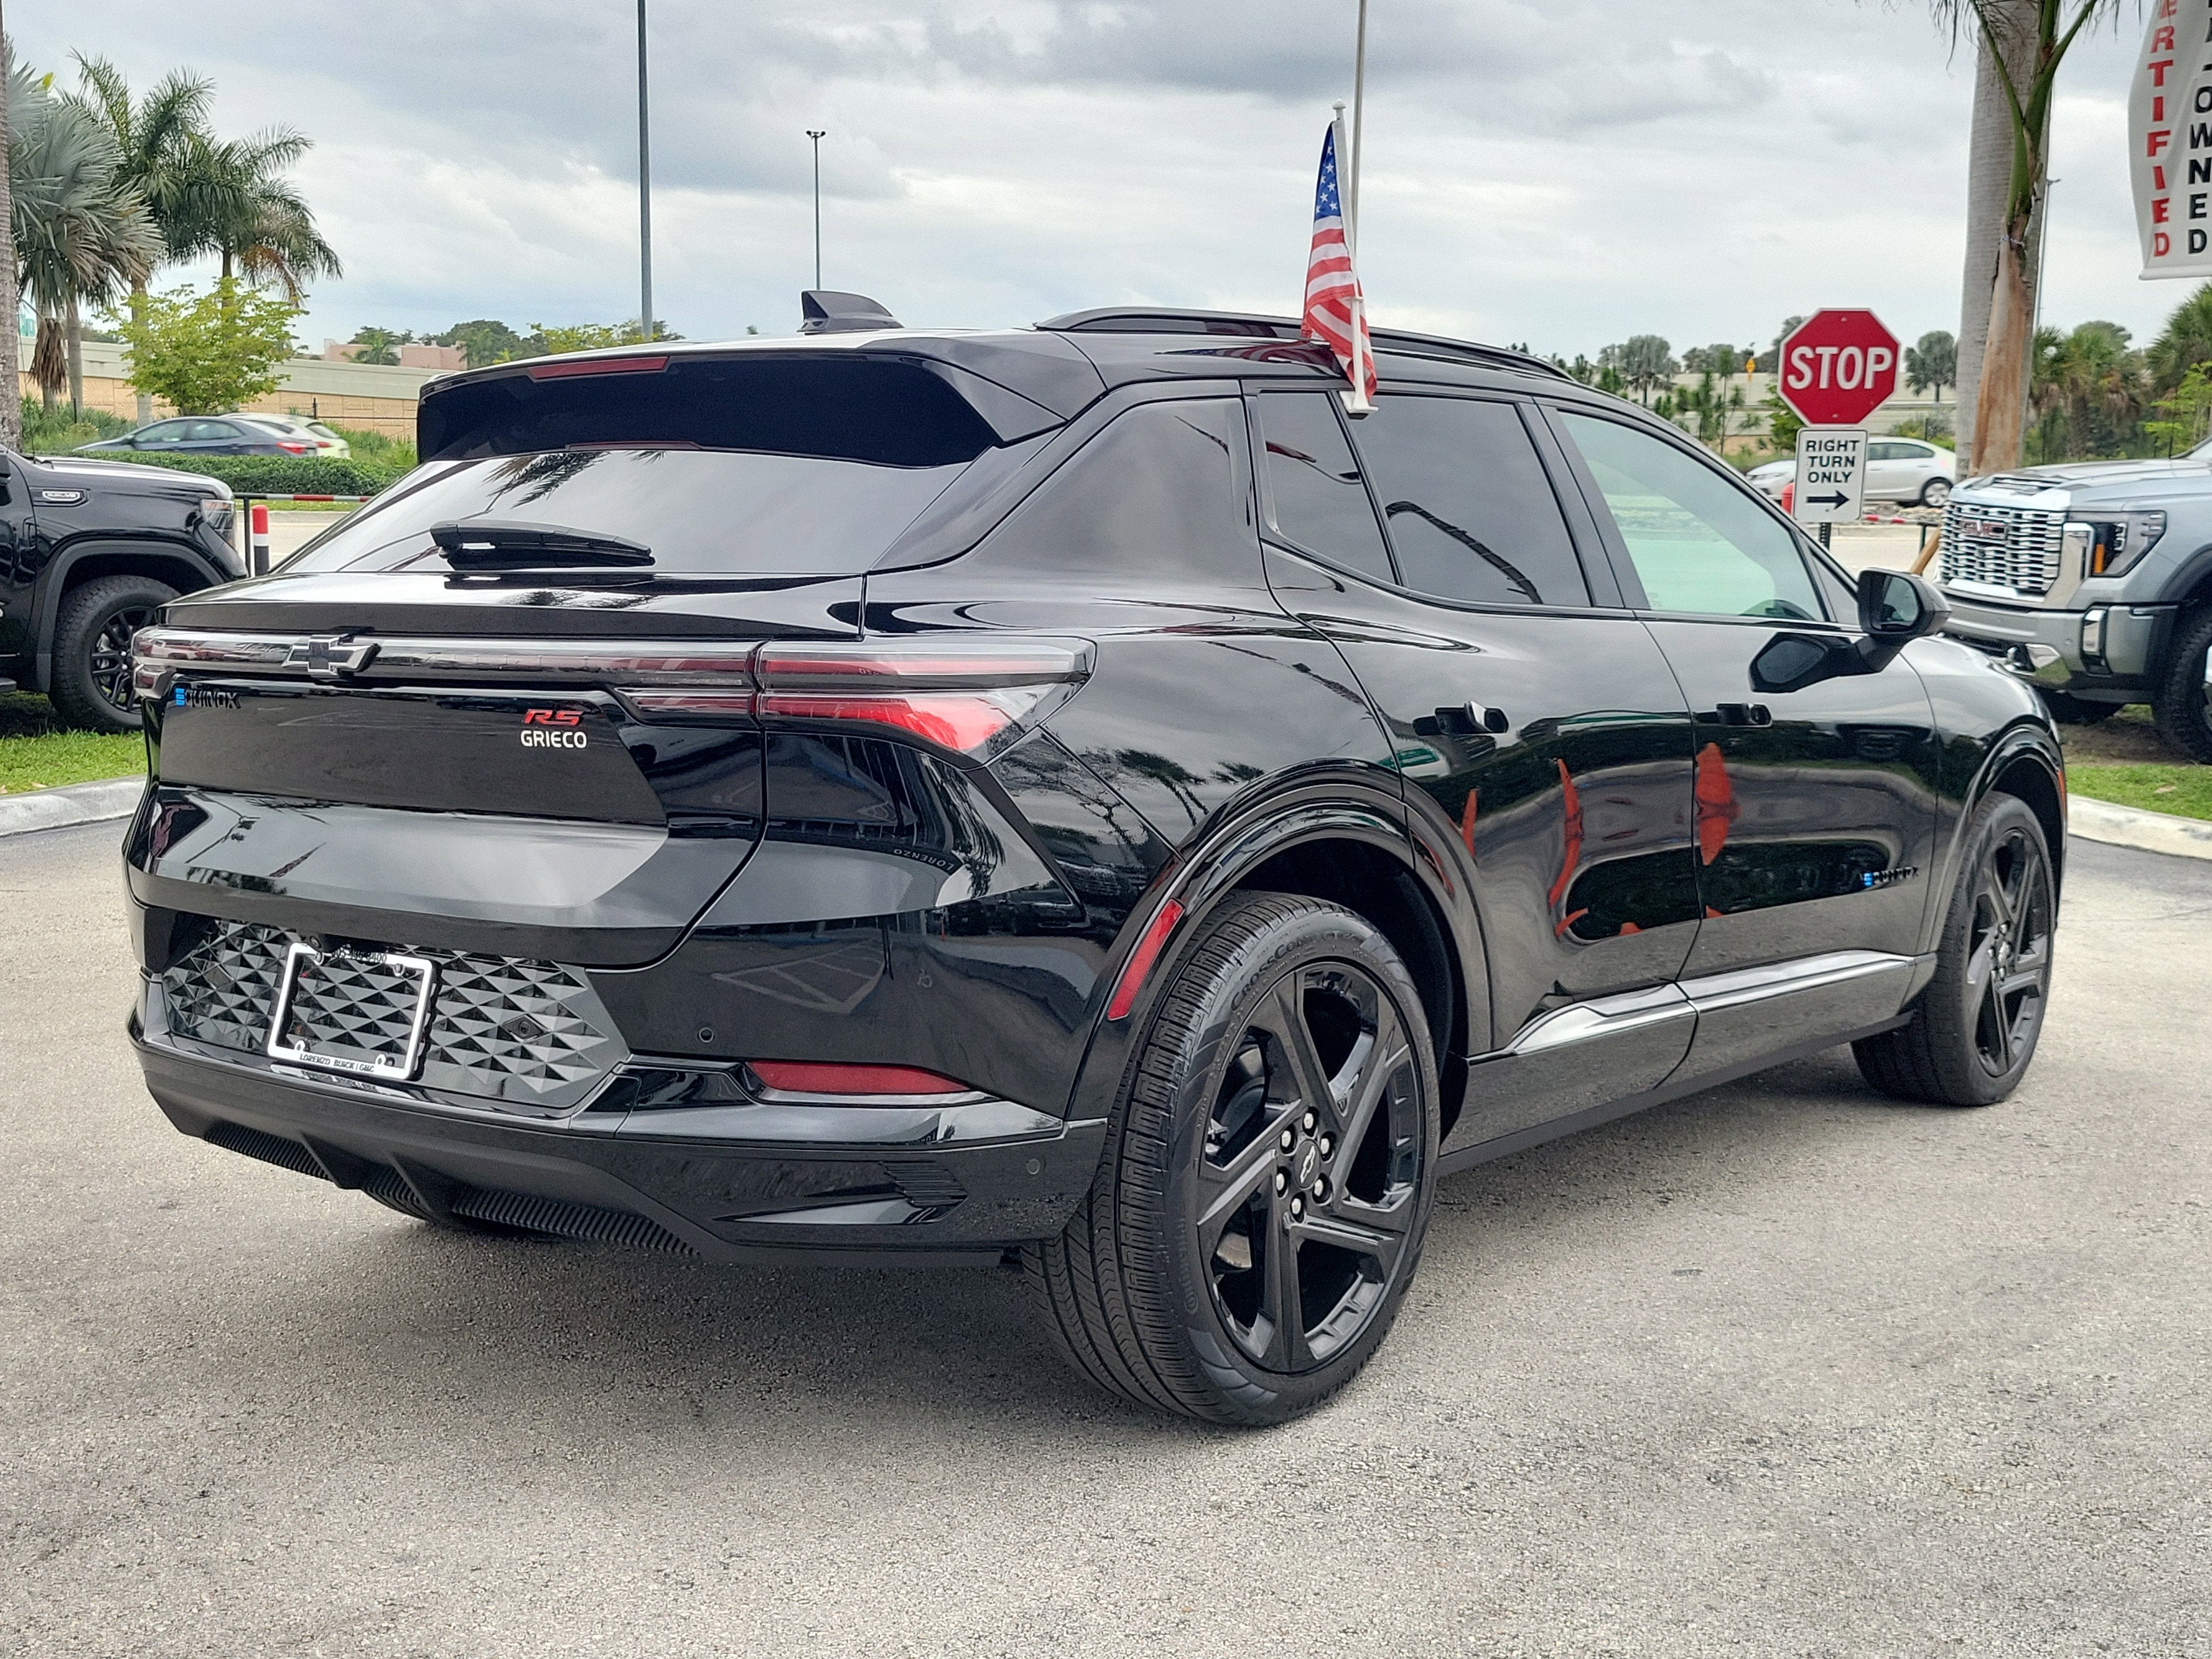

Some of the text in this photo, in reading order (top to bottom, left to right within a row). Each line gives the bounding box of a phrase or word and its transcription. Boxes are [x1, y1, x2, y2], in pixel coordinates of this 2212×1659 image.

[2188, 0, 2212, 255] -OWNED
[1787, 346, 1893, 390] STOP
[1805, 439, 1860, 453] RIGHT
[1808, 455, 1855, 468] TURN
[1808, 471, 1853, 483] ONLY
[522, 708, 584, 726] RS
[520, 730, 587, 749] GRIECO
[300, 1053, 331, 1065] LORENZO
